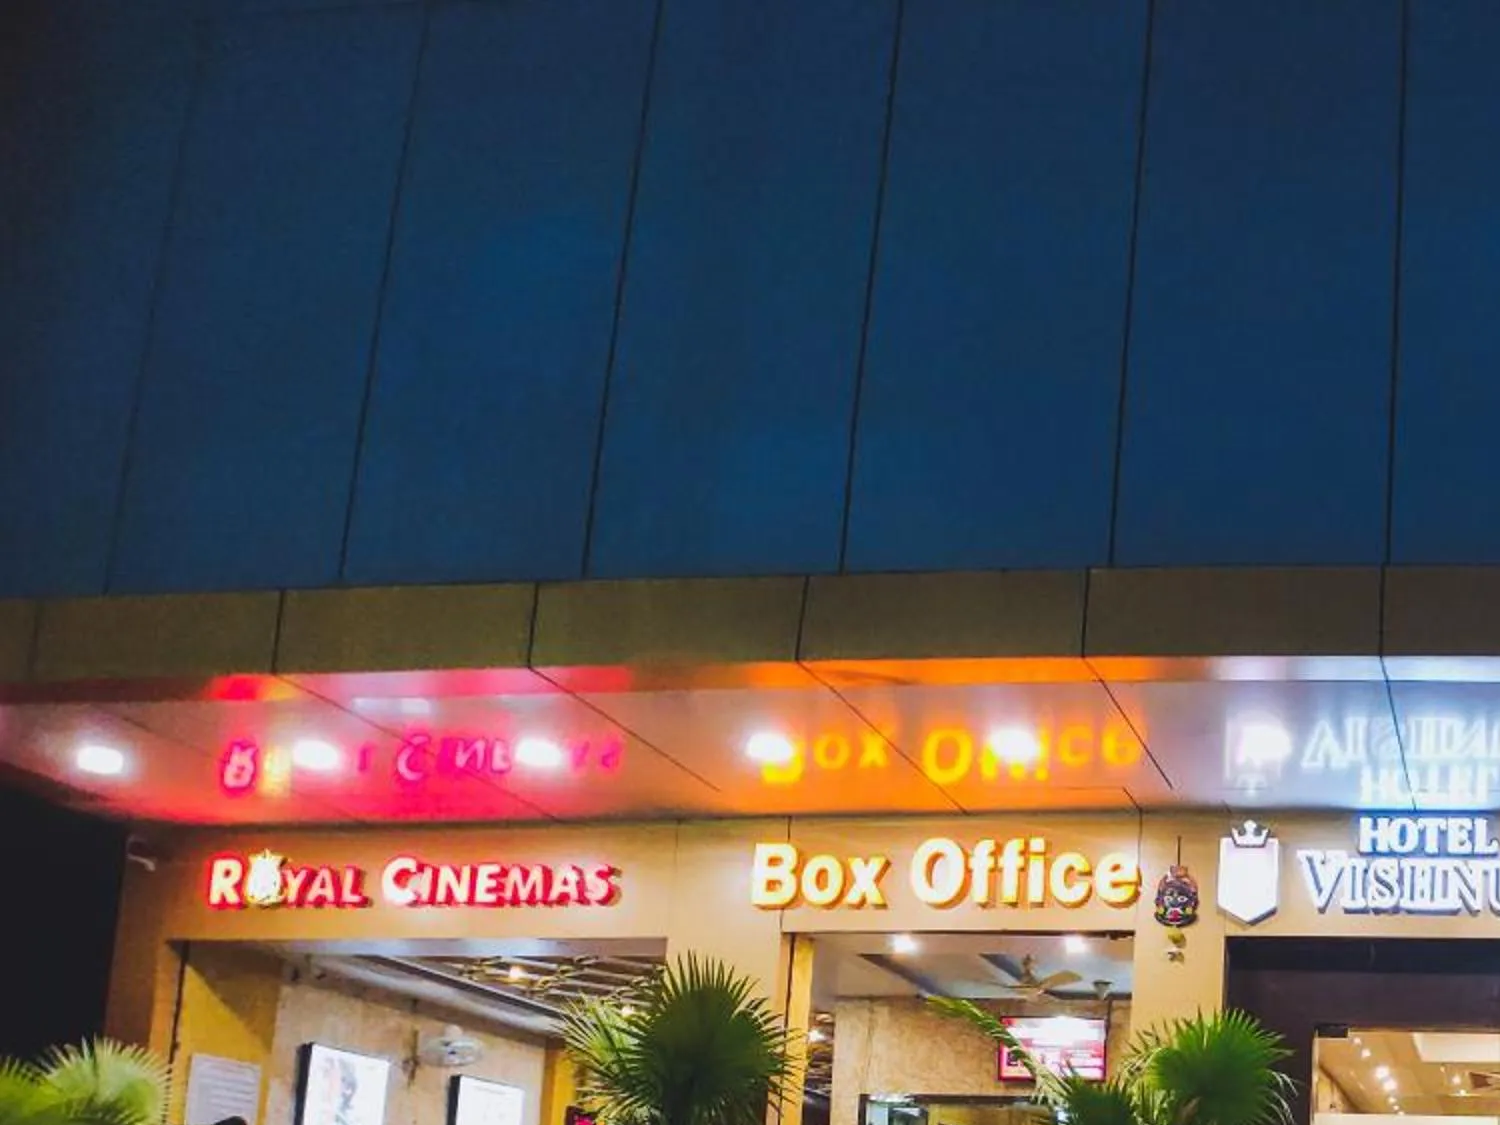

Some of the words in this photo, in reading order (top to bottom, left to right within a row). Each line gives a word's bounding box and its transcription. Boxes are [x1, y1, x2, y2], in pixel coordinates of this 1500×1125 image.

[1357, 816, 1500, 857] HOTEL
[206, 849, 373, 910] ROYAL
[381, 856, 621, 907] CINEMAS
[750, 839, 891, 910] Box
[910, 836, 1143, 910] Office
